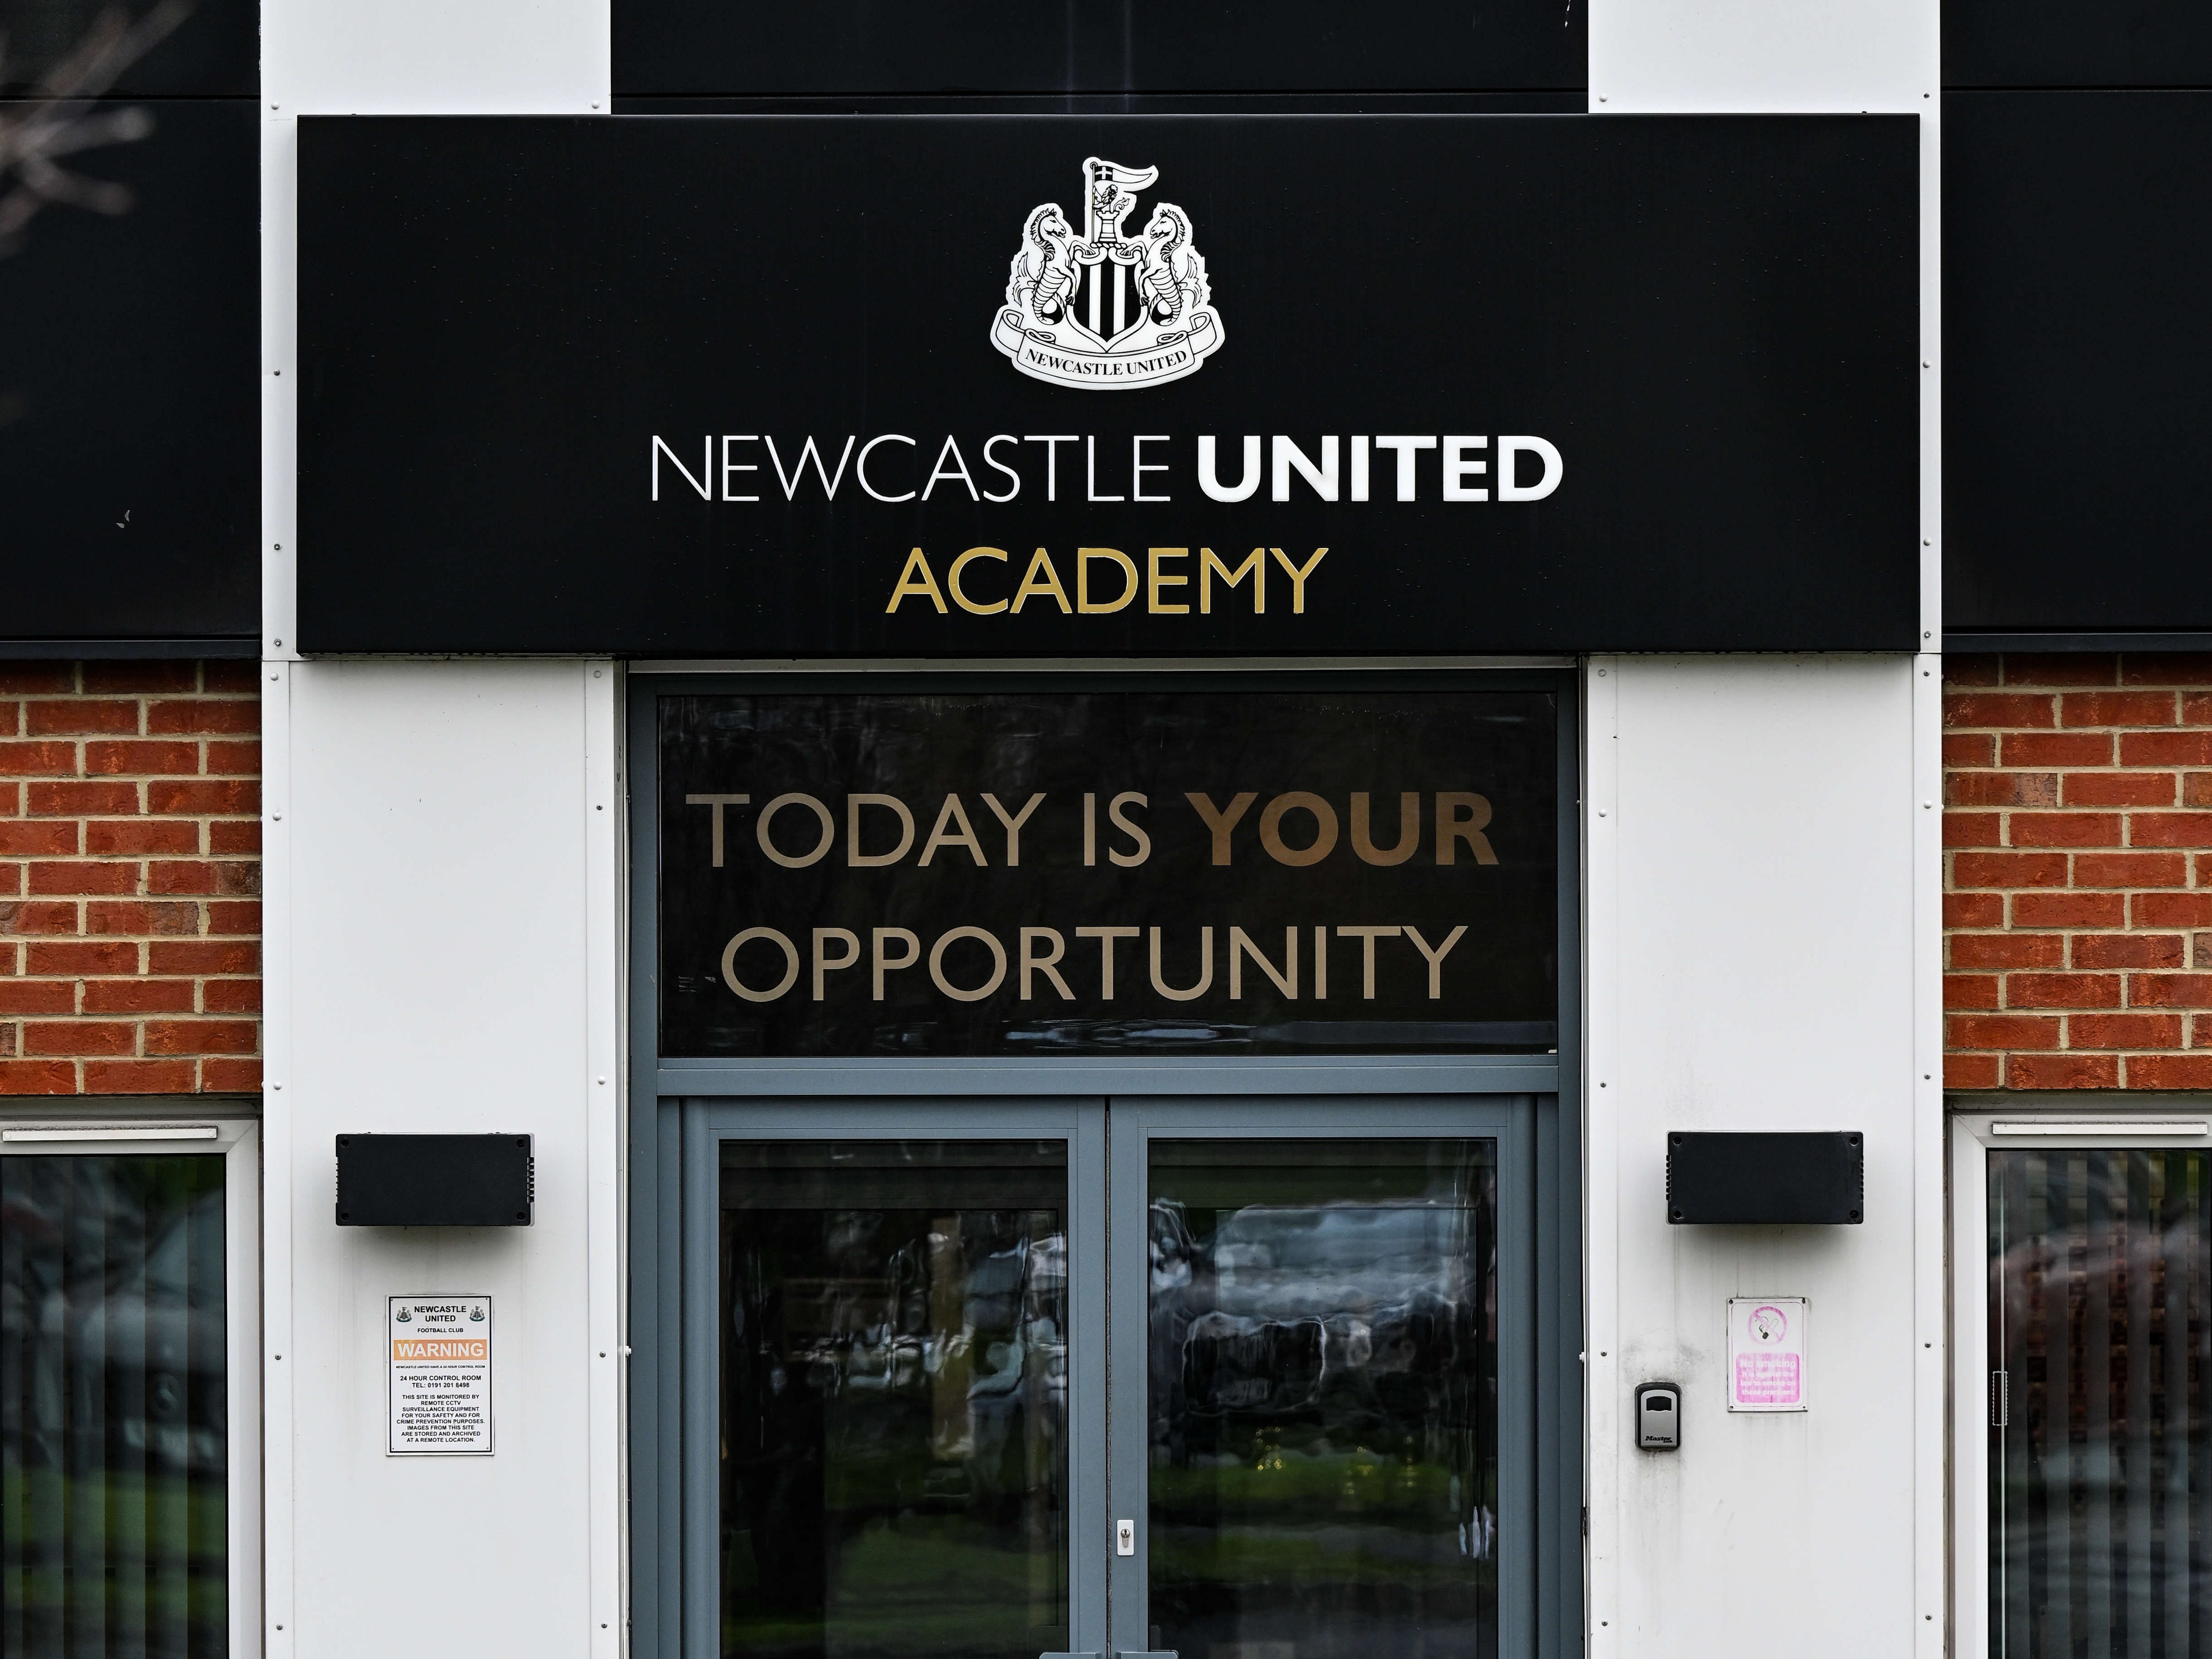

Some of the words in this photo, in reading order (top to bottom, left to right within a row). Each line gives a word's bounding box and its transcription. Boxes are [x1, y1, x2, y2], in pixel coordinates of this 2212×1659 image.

[1025, 348, 1123, 376] NEWCASTLE
[1127, 350, 1187, 375] UNITED
[650, 434, 1172, 503] NEWCASTLE
[1196, 434, 1564, 504] UNITED
[884, 546, 1330, 615] ACADEMY
[685, 792, 1048, 869] TODAY
[1083, 790, 1152, 868] IS
[1184, 790, 1499, 867] YOUR
[720, 925, 1469, 1003] OPPORTUNITY
[397, 1342, 483, 1357] WARNING
[1740, 1359, 1753, 1367] No
